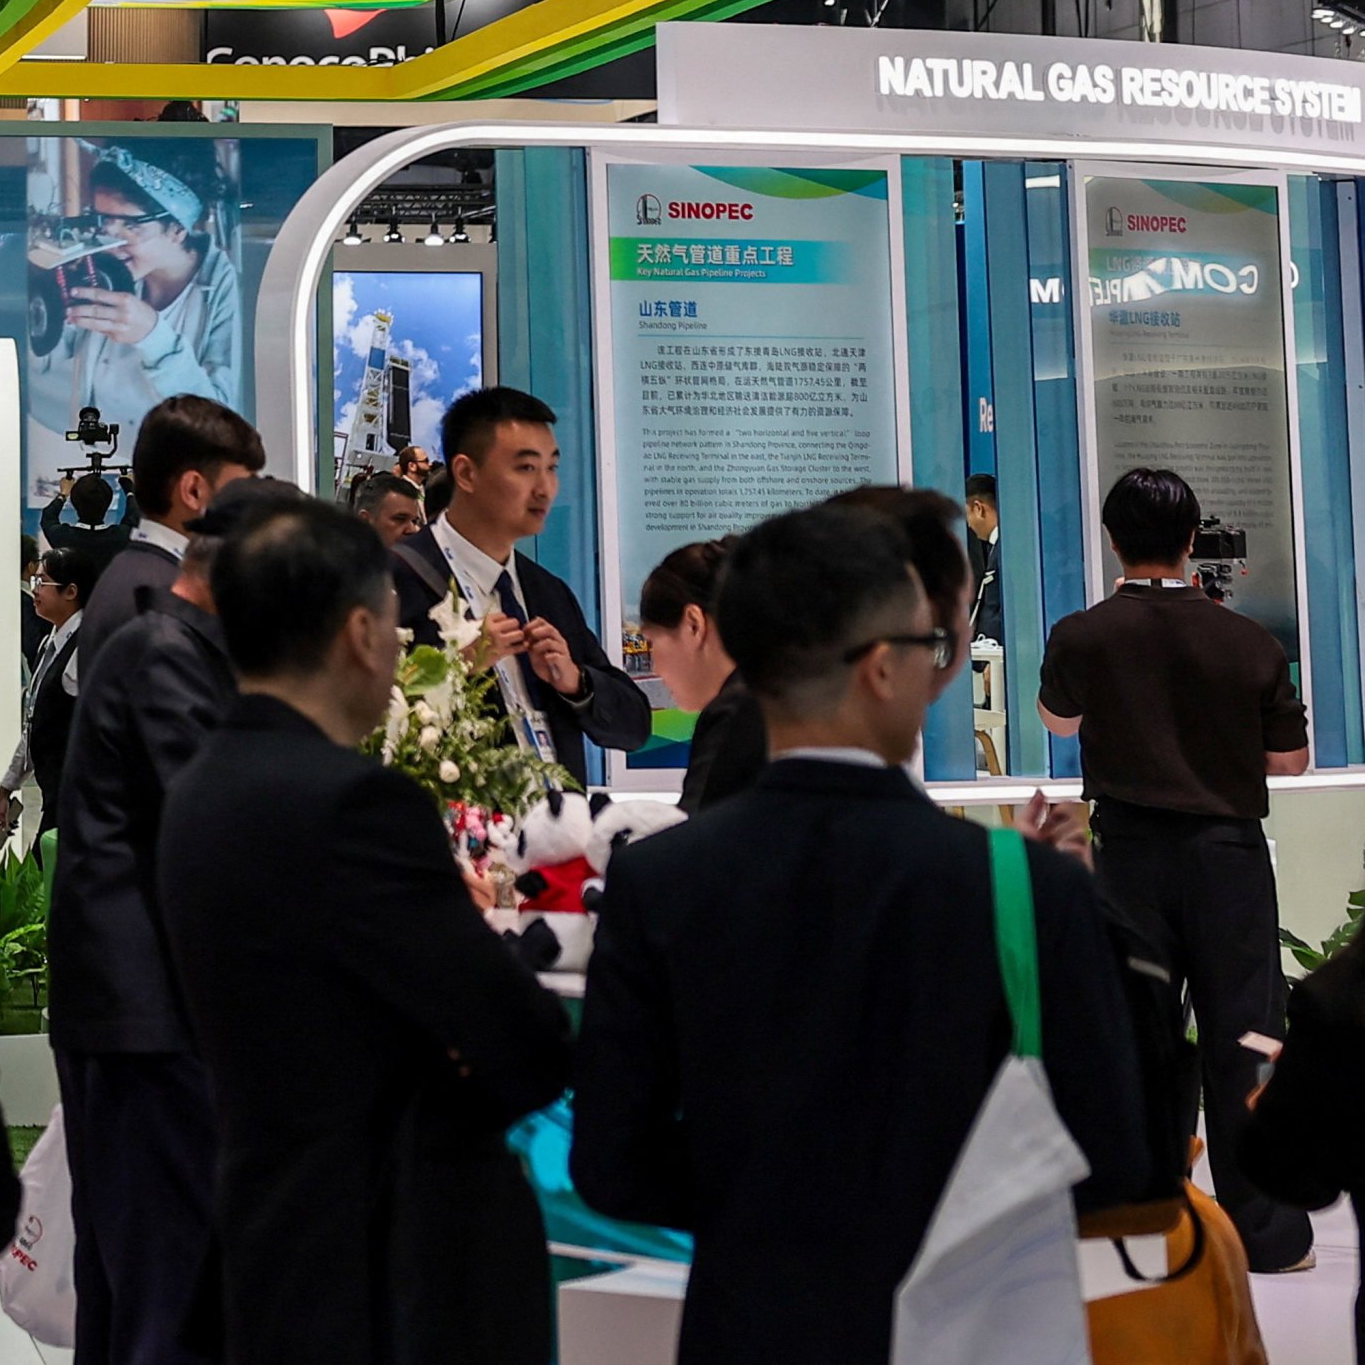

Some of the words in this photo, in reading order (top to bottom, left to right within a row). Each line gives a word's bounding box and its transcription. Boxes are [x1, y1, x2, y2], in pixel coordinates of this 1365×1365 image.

[878, 57, 1045, 102] NATURAL
[1048, 62, 1115, 104] GAS
[1122, 67, 1271, 115] RESOURCE
[1272, 79, 1362, 124] SYSTEM
[668, 202, 754, 221] SINOPEC
[1127, 215, 1188, 233] SINOPEC
[637, 244, 794, 266] 天然气管道重点工程
[637, 267, 652, 277] Key
[654, 267, 683, 276] Natural
[684, 268, 700, 277] Gas
[701, 268, 733, 278] Pipeline
[735, 269, 767, 279] Projects
[638, 300, 698, 317] 山东管道
[638, 321, 677, 330] Shandong
[678, 322, 707, 331] Pipeline
